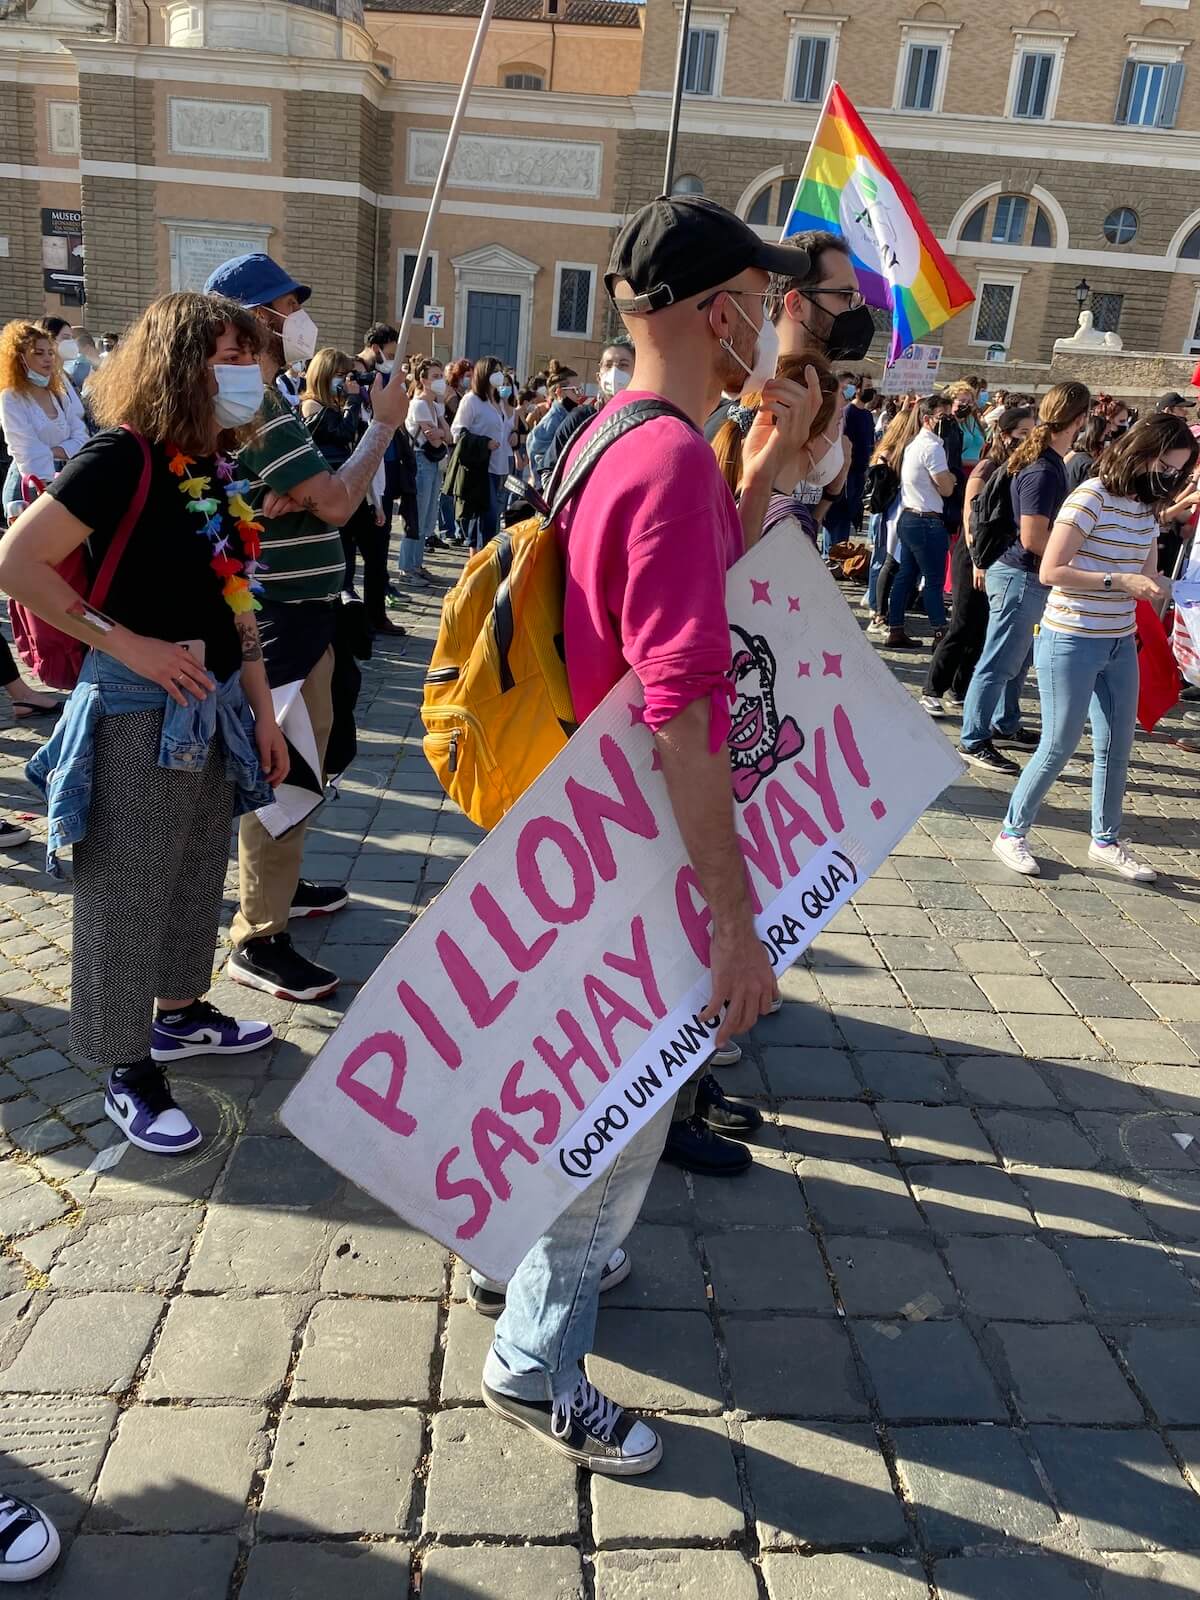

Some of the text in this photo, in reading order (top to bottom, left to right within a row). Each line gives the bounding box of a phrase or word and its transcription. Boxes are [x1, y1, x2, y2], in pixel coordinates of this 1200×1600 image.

[51, 211, 80, 222] MUSEO
[335, 734, 660, 1138] PILLON
[435, 915, 668, 1241] SASHAY
[559, 1104, 629, 1178] (DOPO
[623, 1064, 663, 1108] UN
[801, 850, 858, 905] QUA)
